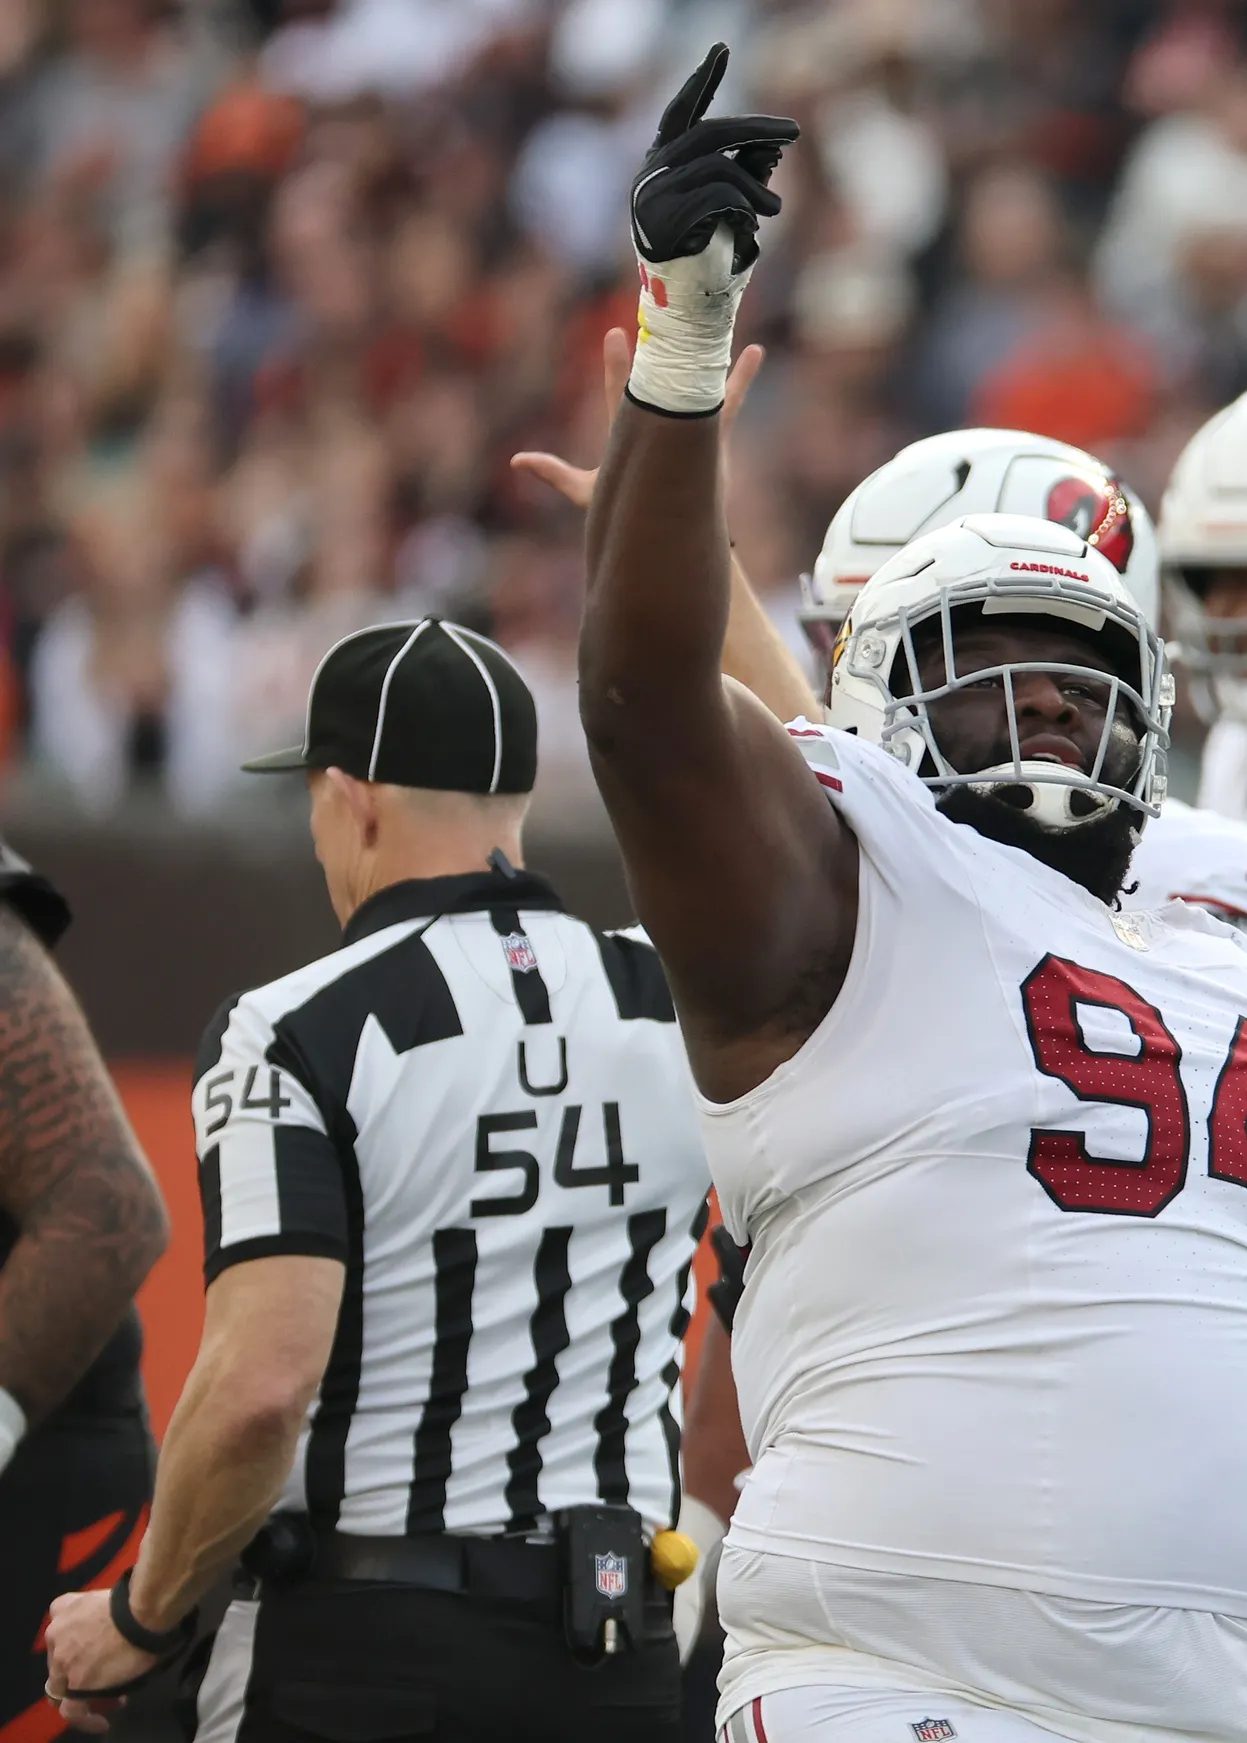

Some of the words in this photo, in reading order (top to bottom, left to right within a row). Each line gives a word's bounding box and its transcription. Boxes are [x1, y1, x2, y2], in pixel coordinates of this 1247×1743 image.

[1009, 562, 1090, 582] CARDINALS
[508, 948, 537, 966] NFL
[518, 1037, 568, 1096] U
[203, 1065, 291, 1137] 54
[470, 1102, 639, 1218] 54
[600, 1573, 622, 1591] NFL
[920, 1727, 950, 1740] NFL
